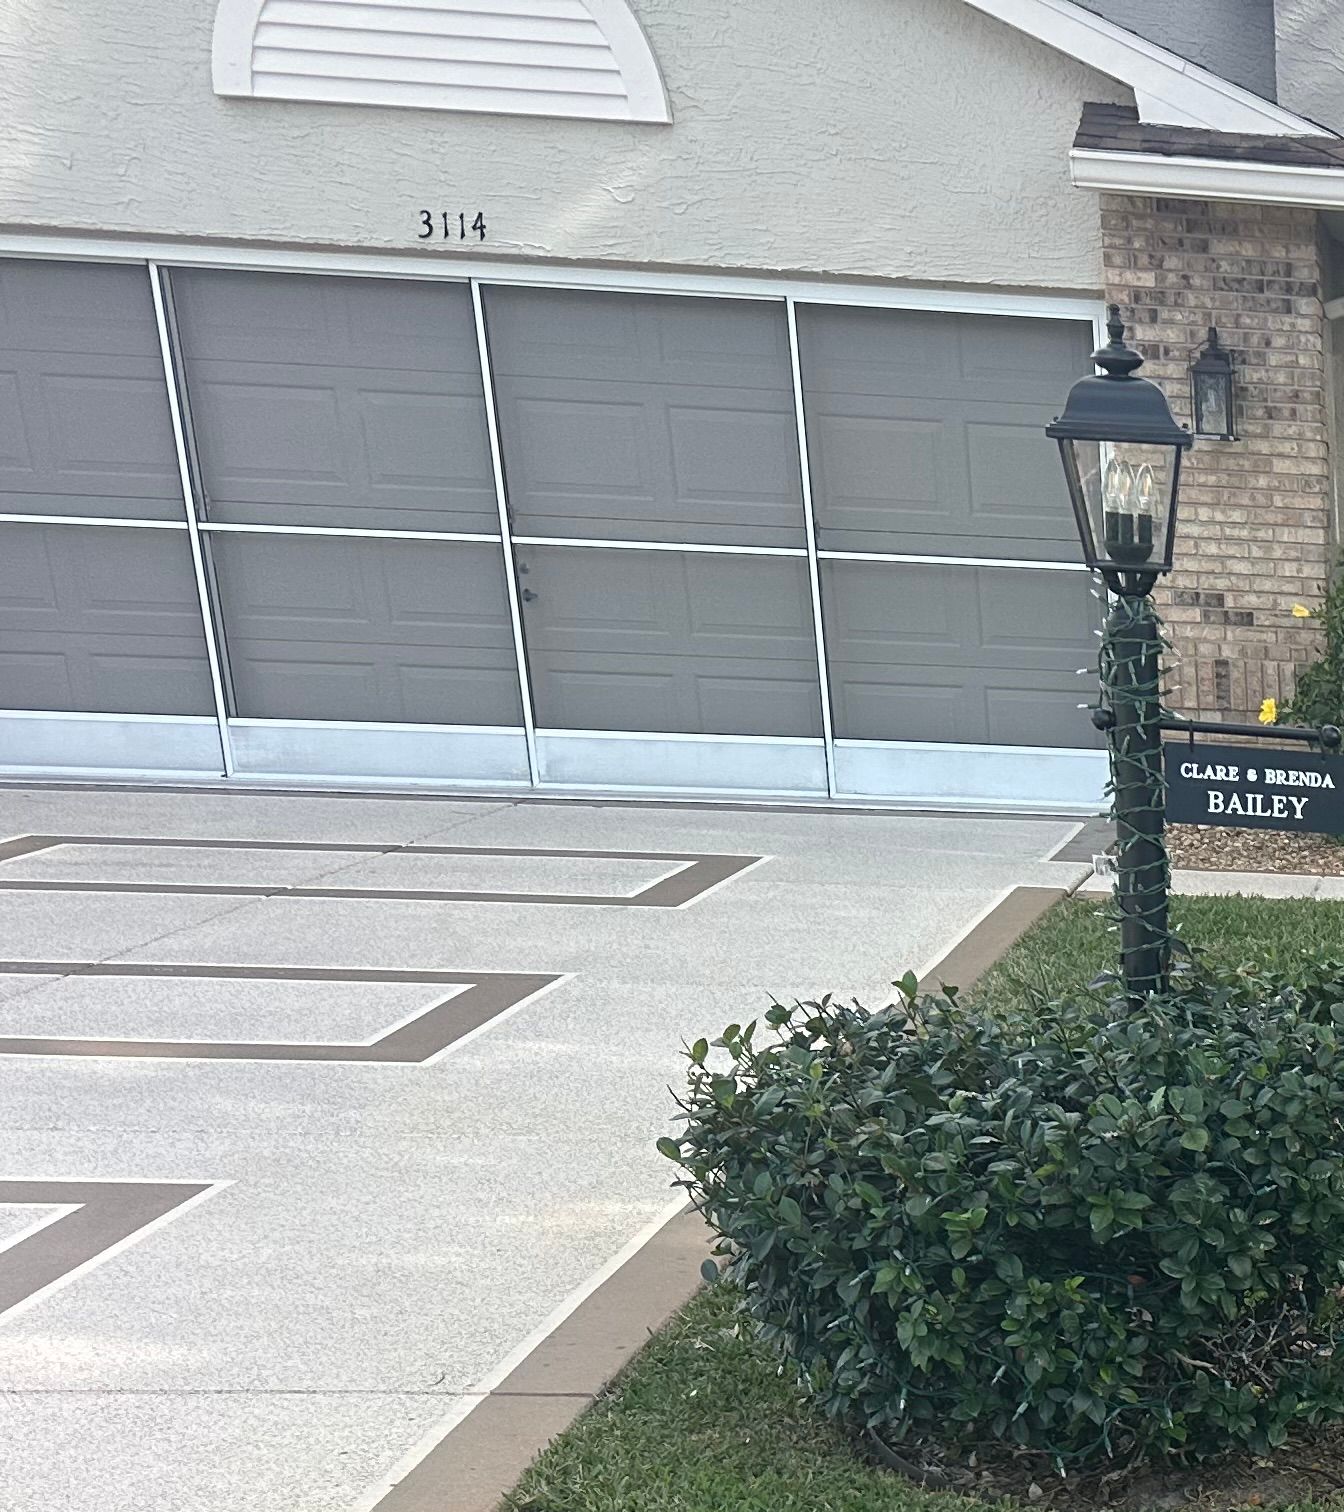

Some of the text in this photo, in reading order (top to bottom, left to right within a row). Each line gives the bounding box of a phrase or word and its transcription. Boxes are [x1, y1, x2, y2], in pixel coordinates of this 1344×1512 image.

[418, 209, 487, 241] 3114
[1180, 762, 1240, 782] CLARE
[1264, 768, 1336, 789] BRENDA
[1207, 790, 1309, 820] BAILEY
